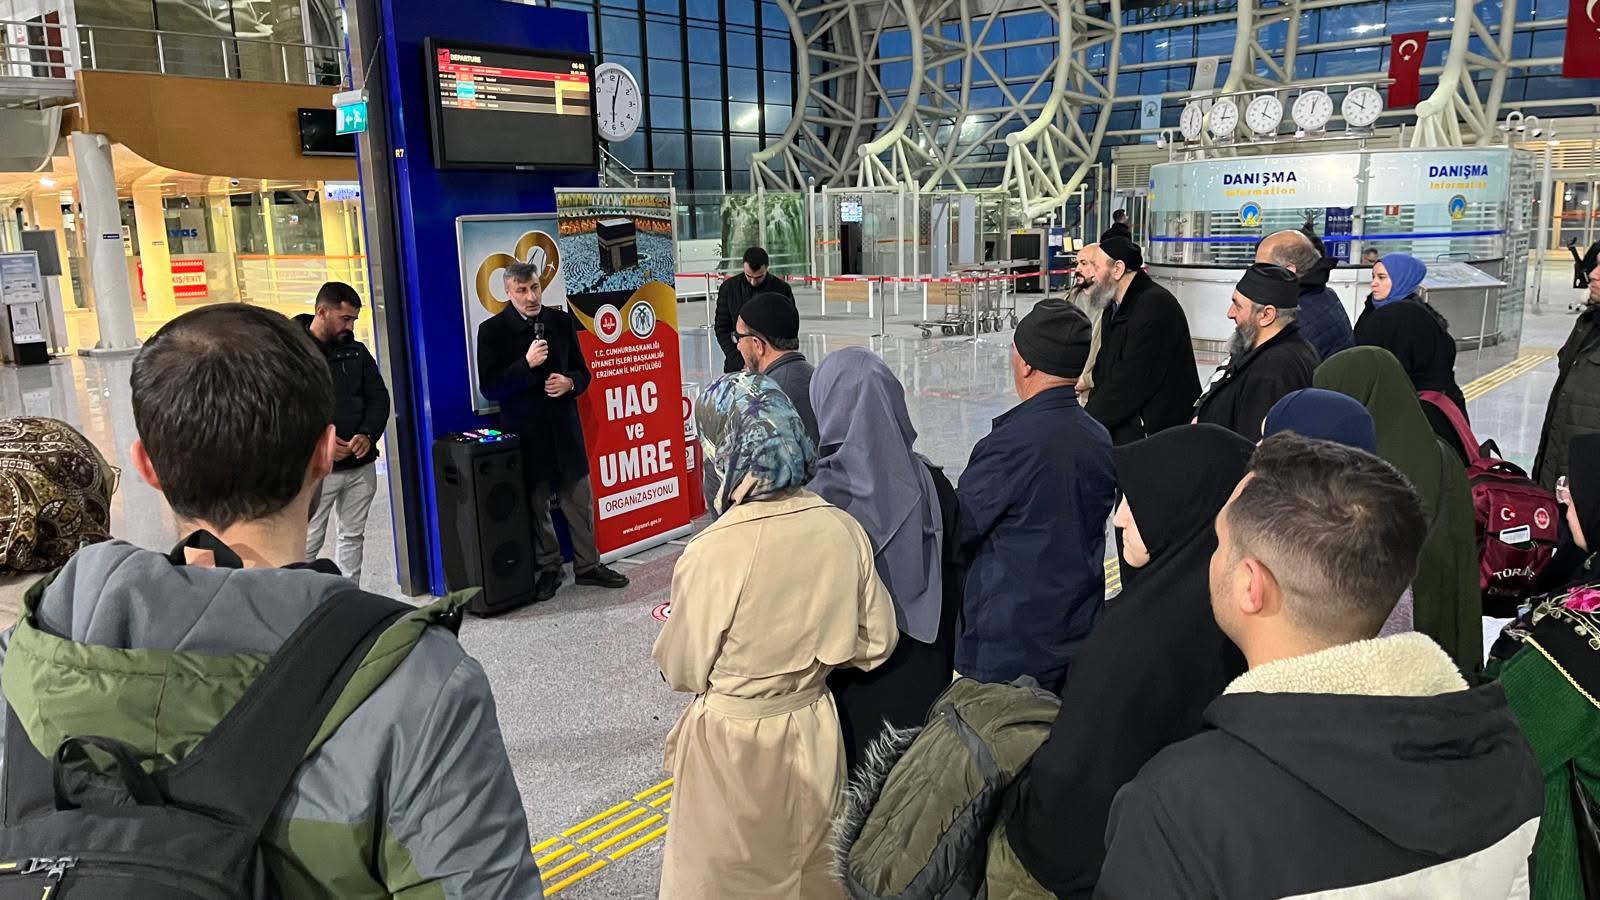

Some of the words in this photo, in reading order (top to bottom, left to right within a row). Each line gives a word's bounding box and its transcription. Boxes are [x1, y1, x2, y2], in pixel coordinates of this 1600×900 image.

[450, 54, 482, 63] DEPARTURE
[1223, 171, 1297, 186] DANIŞMA
[1429, 164, 1489, 179] DANIŞMA
[594, 350, 606, 358] T.C.
[606, 341, 660, 356] CUMHURBAŞKANLIĞI
[591, 358, 615, 369] DİYANET
[615, 354, 633, 365] İŞLERİ
[633, 350, 665, 363] BAŞKANLIĞI
[596, 367, 624, 379] ERZİNCAN
[623, 366, 630, 374] İL
[630, 361, 662, 373] MÜFTÜLÜĞÜ
[605, 381, 658, 422] HAC
[625, 422, 645, 441] ve
[599, 439, 673, 488] UMRE
